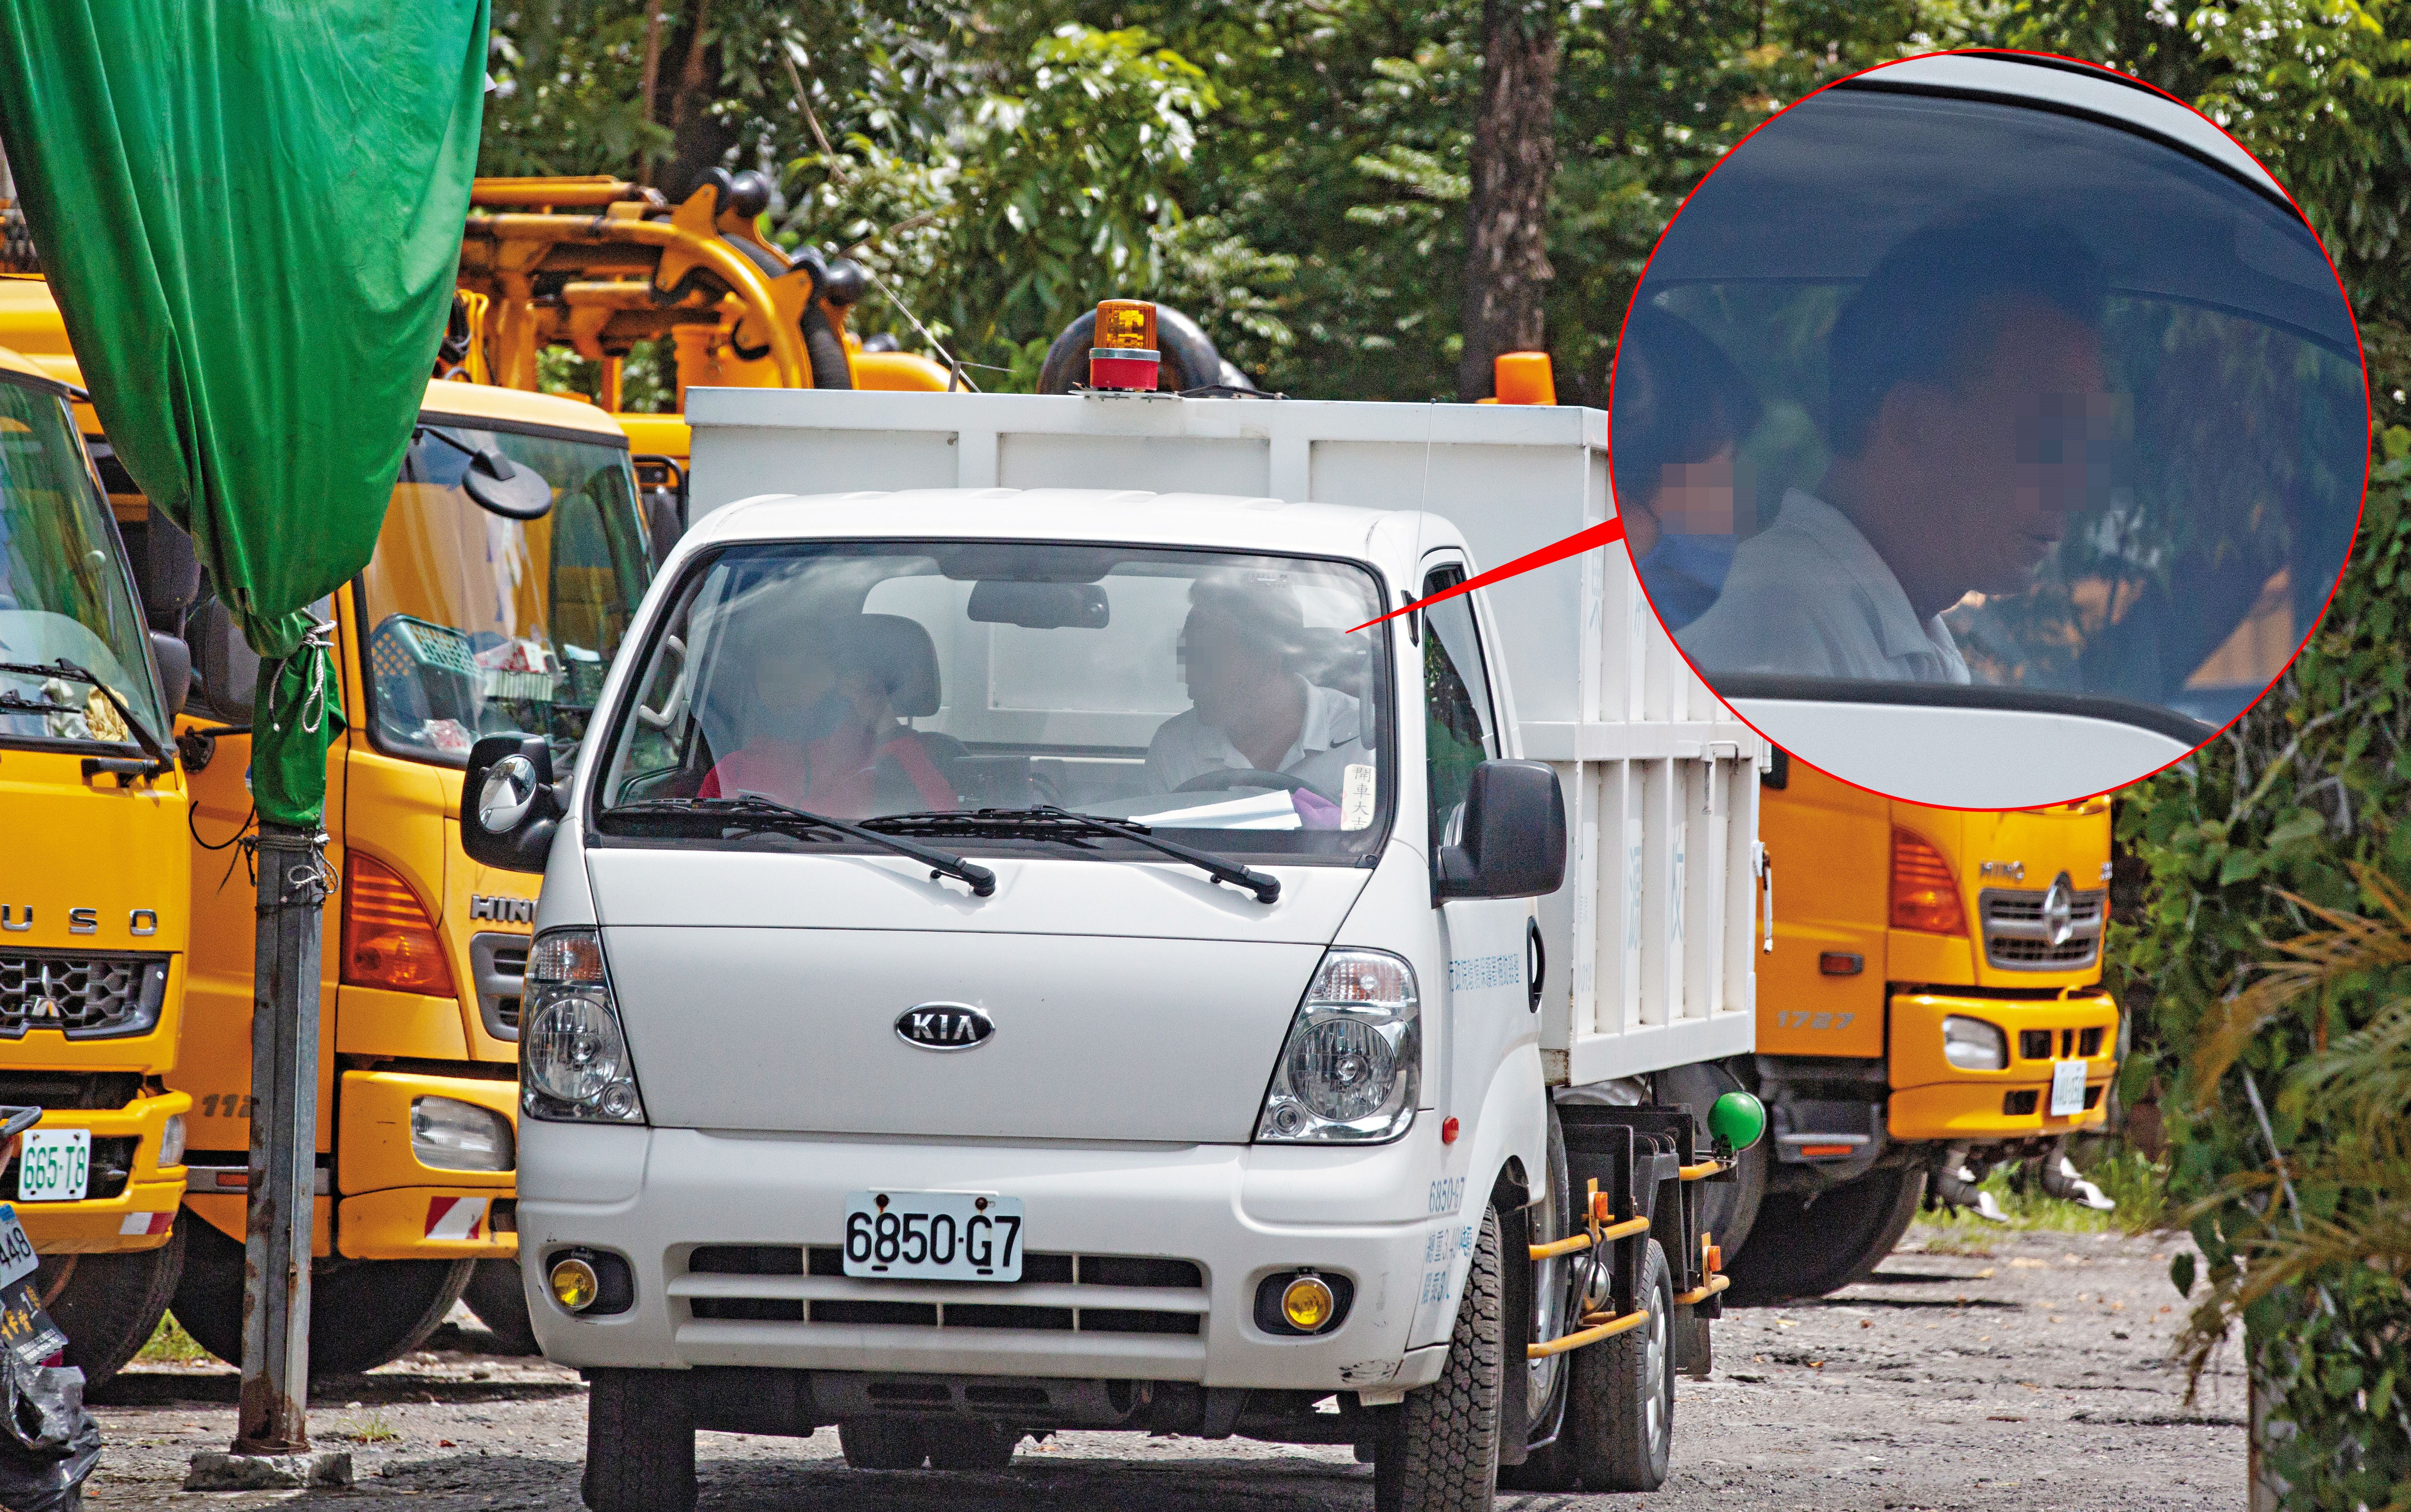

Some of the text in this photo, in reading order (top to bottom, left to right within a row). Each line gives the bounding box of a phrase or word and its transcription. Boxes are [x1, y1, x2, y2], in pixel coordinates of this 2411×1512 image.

[1351, 767, 1372, 831] 開車大吉
[1, 904, 158, 936] USO
[470, 895, 538, 924] HIN
[912, 1013, 976, 1041] KIA
[1777, 1010, 1854, 1029] 1727
[1429, 1177, 1465, 1212] 6850-G7
[846, 1212, 1021, 1268] 6850-G7
